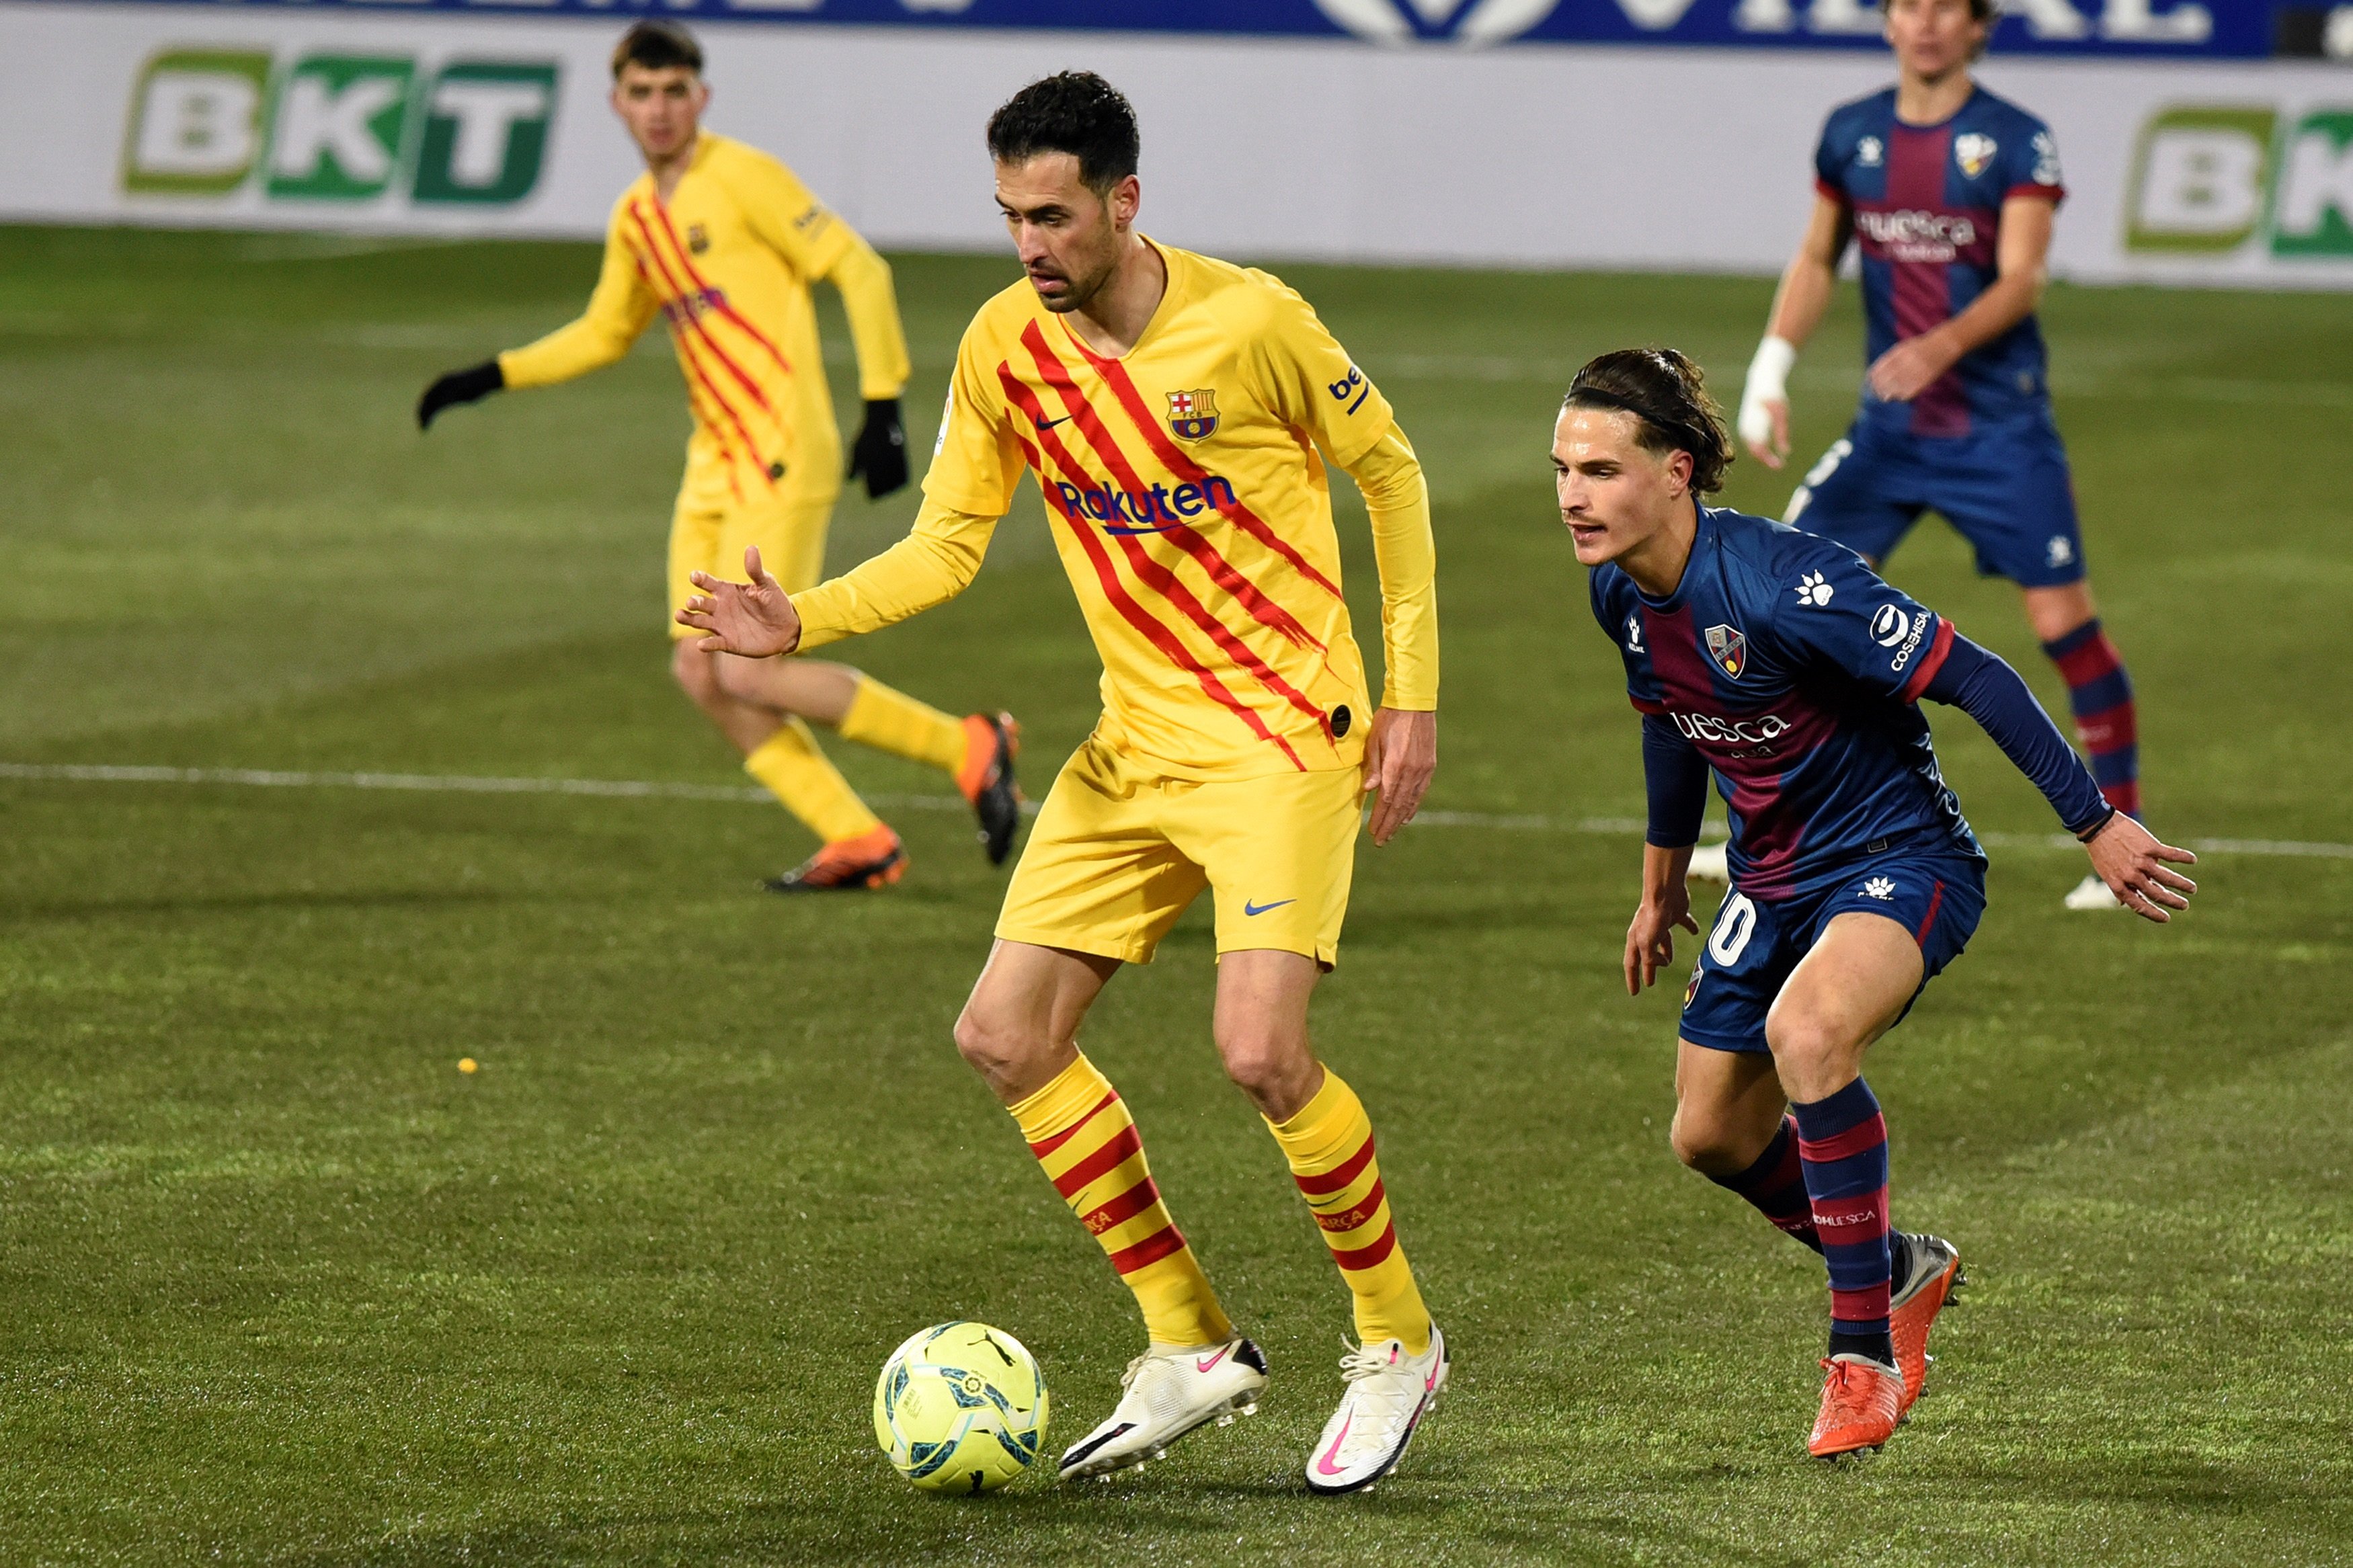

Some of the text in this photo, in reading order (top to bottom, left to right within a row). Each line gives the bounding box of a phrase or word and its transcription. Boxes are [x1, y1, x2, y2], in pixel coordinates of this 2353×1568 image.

[132, 66, 549, 191] BKT
[1055, 475, 1236, 524] Rakuten
[1890, 612, 1929, 672] COSEHISA
[1669, 711, 1792, 743] uesca
